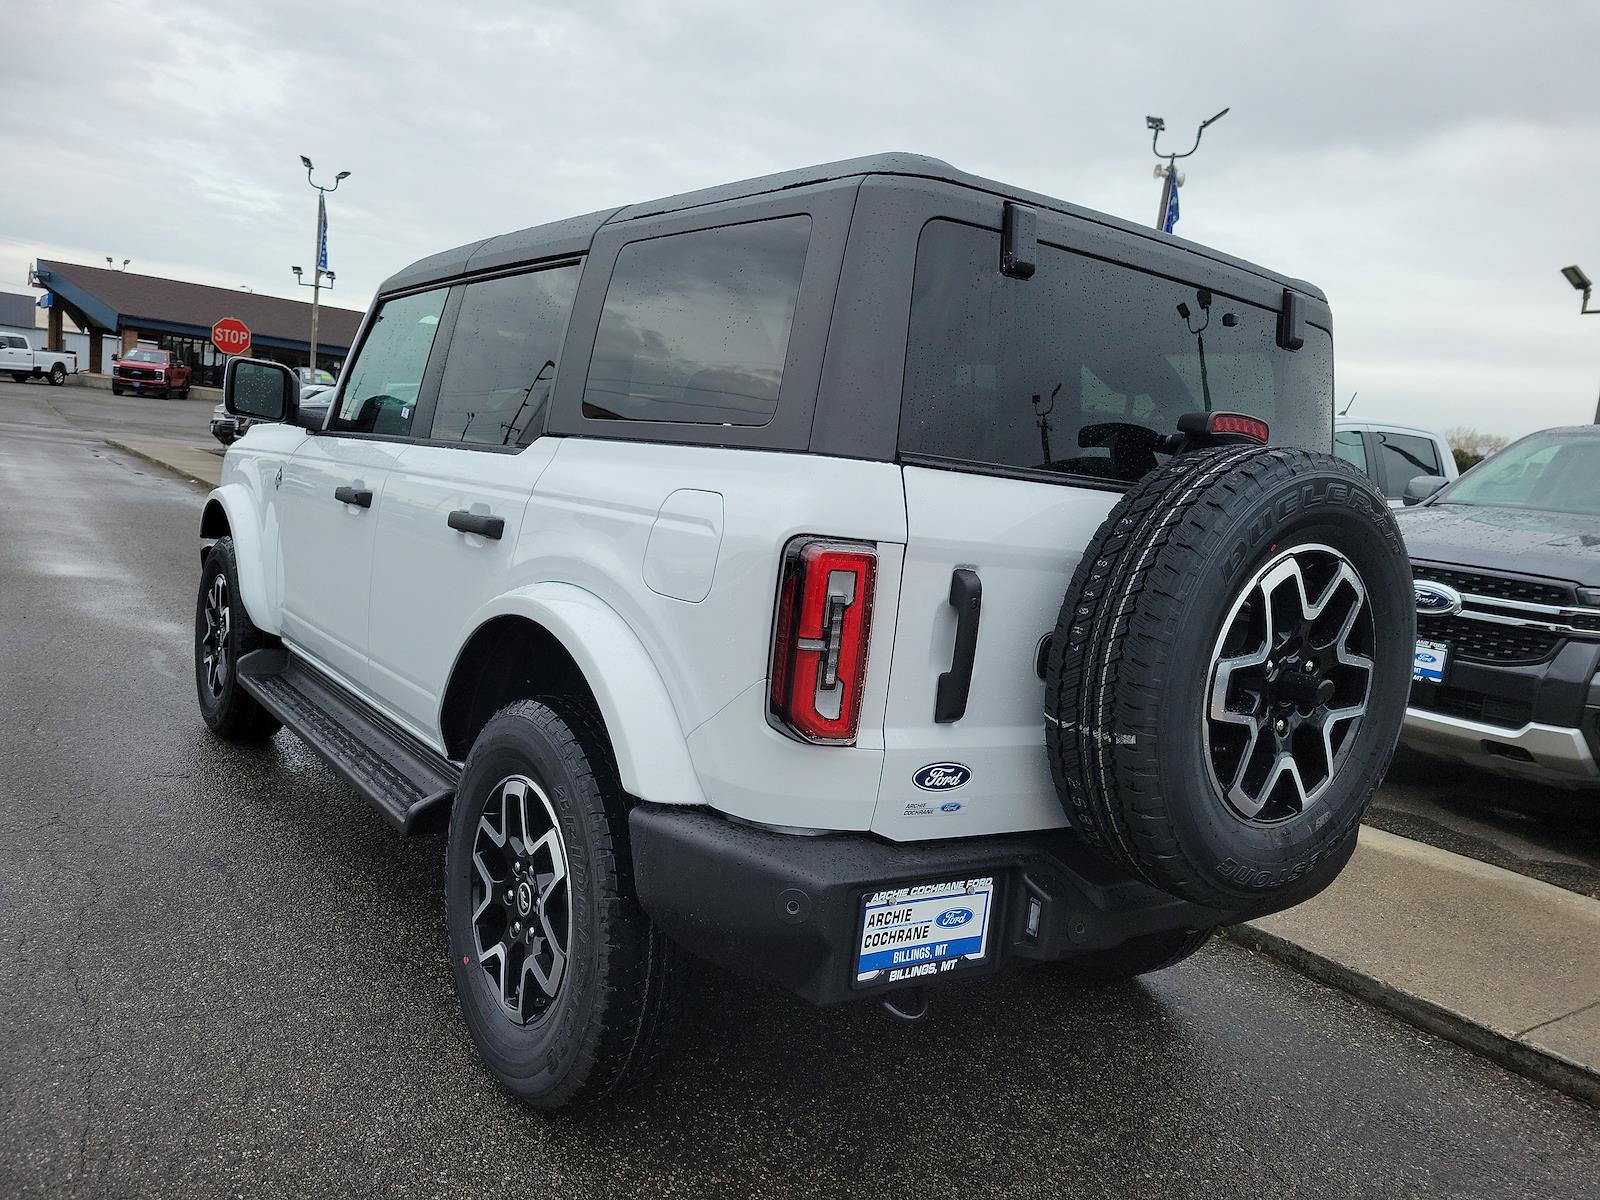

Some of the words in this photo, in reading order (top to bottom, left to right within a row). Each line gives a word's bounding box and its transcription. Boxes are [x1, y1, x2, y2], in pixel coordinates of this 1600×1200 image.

[215, 328, 248, 344] STOP
[1221, 483, 1372, 584] DUELER
[925, 768, 962, 786] Ford
[871, 890, 909, 903] ARCHIE
[910, 881, 965, 896] COCHRANE
[965, 877, 993, 890] FORD
[867, 909, 912, 928] ARCHIE
[942, 911, 966, 925] Ford
[864, 925, 930, 949] COCHRANE
[893, 948, 933, 963] BILLINGS,
[934, 943, 948, 956] MT
[889, 962, 937, 982] BILLINGS,
[940, 959, 958, 972] MT
